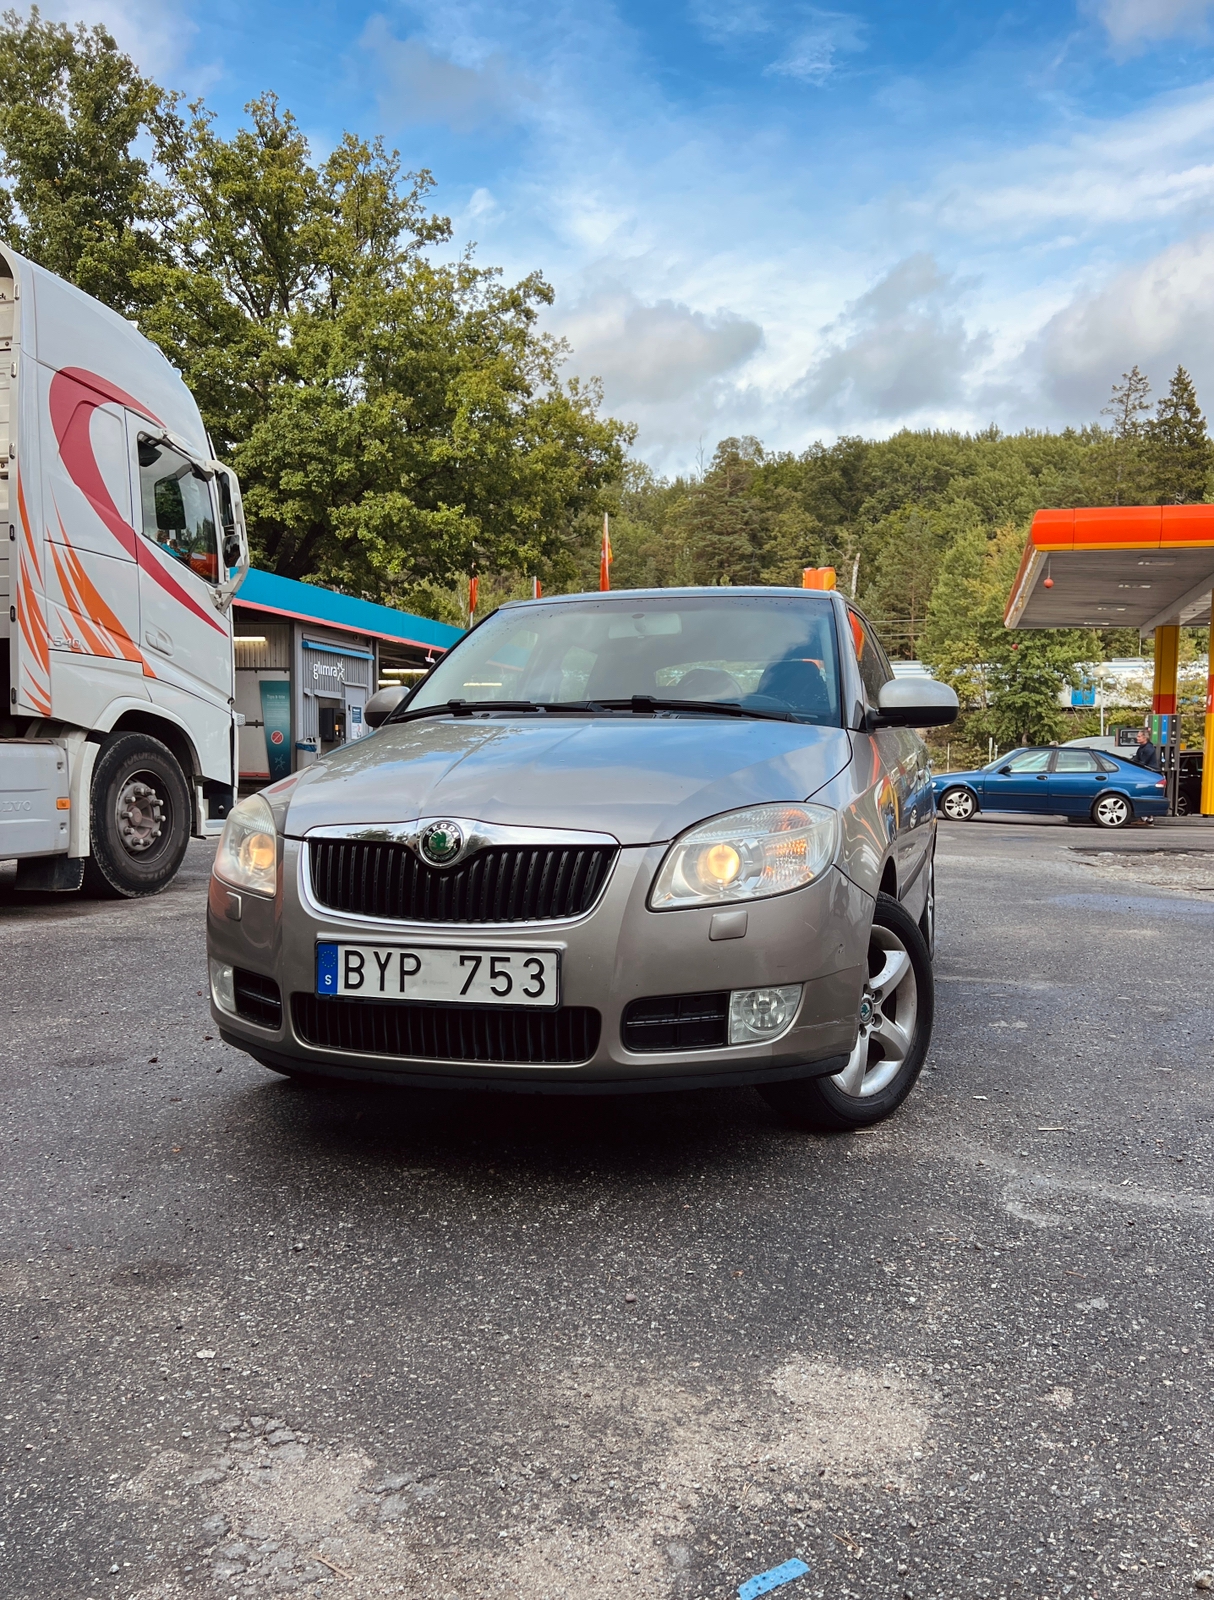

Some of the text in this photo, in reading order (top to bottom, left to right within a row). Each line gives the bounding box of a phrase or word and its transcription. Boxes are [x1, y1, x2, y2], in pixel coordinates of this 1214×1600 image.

[53, 636, 81, 649] 540
[313, 660, 338, 680] glimra
[0, 800, 32, 812] LVO
[324, 974, 332, 986] S
[344, 949, 546, 999] BYP 753
